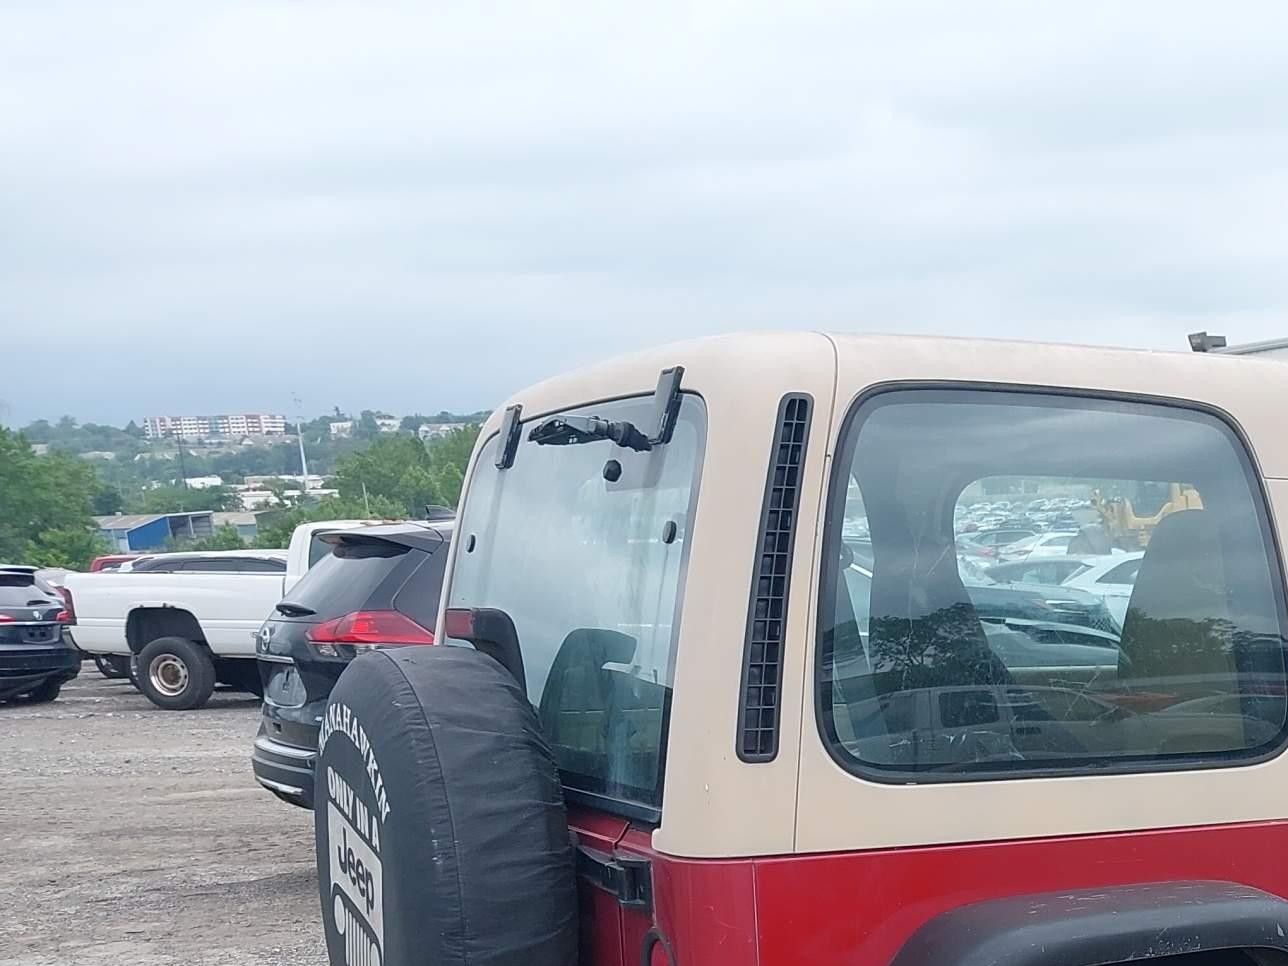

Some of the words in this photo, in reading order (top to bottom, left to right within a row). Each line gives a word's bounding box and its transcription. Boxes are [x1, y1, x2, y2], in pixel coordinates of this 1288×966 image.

[318, 702, 391, 824] MANAHAWKIN
[327, 765, 354, 821] ONLY
[355, 796, 370, 840] IN
[371, 815, 381, 853] A
[337, 827, 374, 913] Jeep
